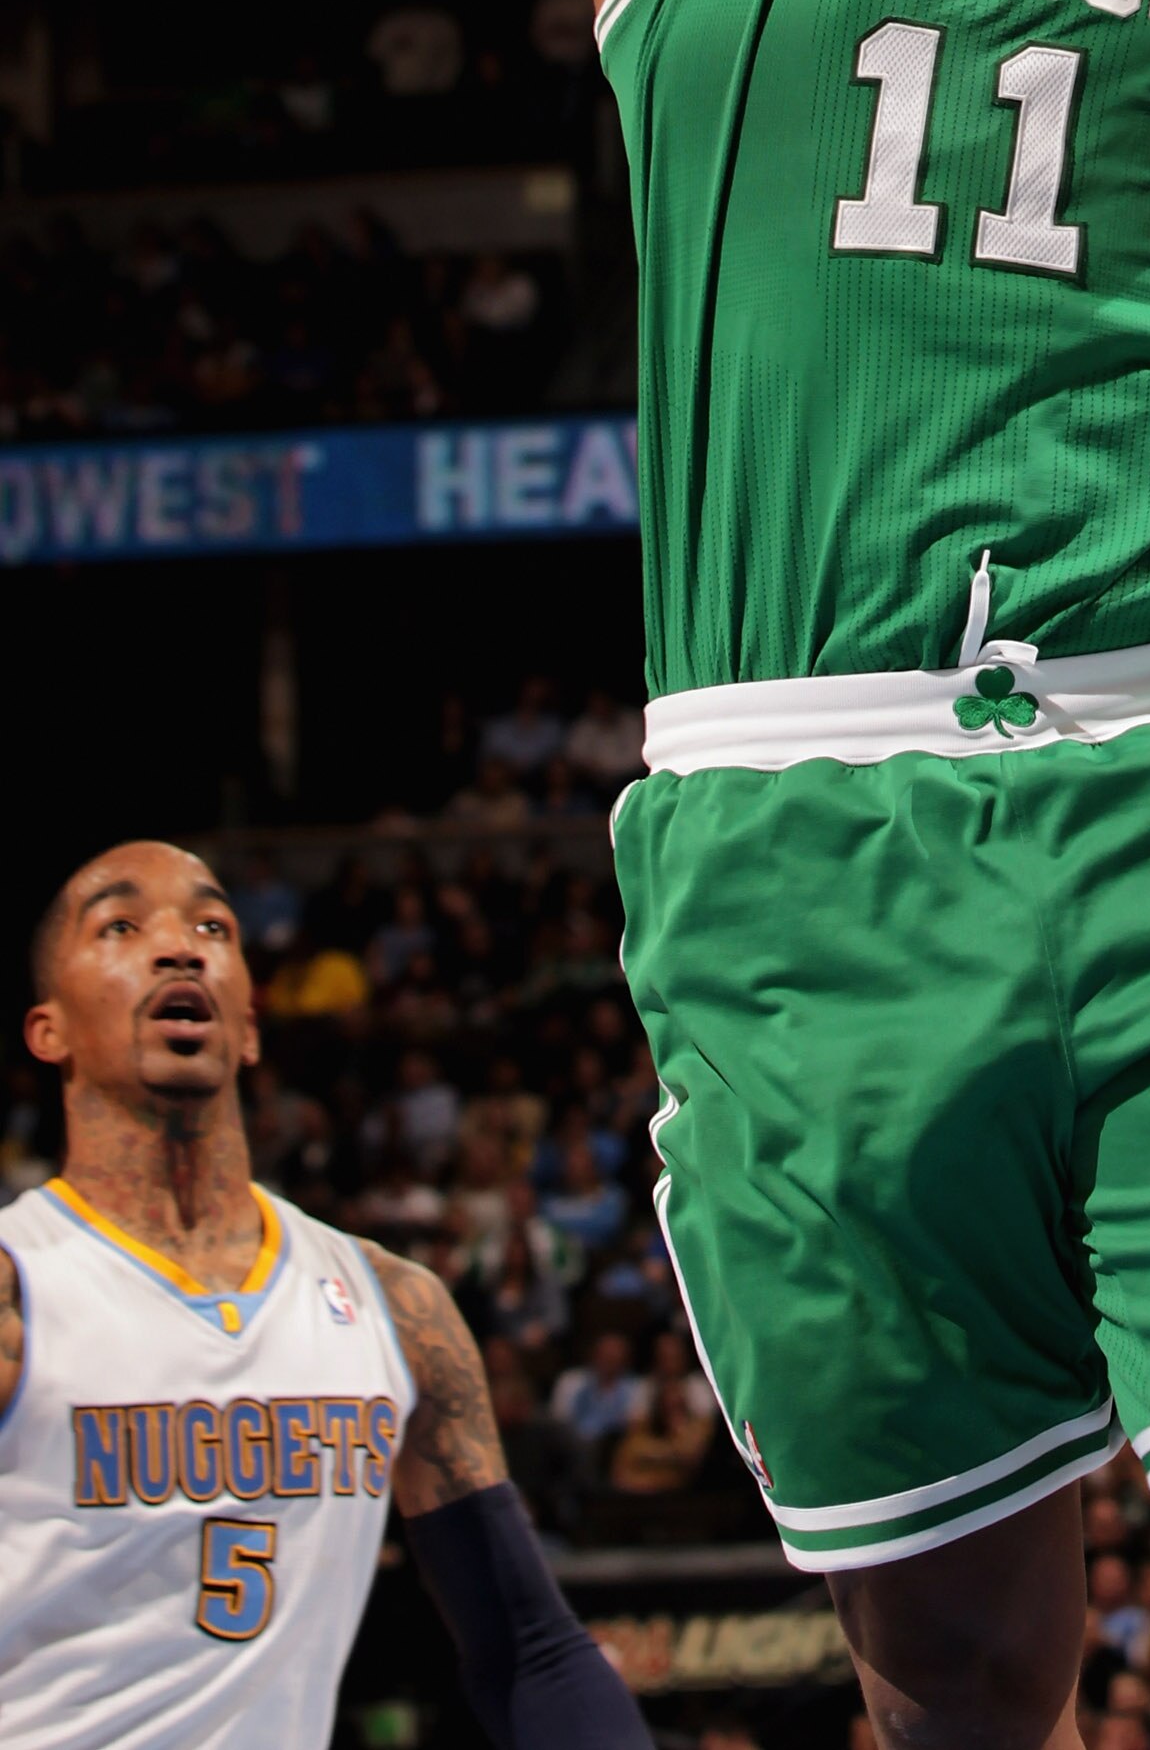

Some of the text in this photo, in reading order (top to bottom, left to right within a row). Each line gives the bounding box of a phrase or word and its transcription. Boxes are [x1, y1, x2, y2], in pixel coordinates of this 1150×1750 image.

[828, 17, 1088, 289] 11
[415, 420, 638, 534] HEA
[73, 1396, 399, 1507] NUGGETS
[195, 1517, 278, 1641] 5
